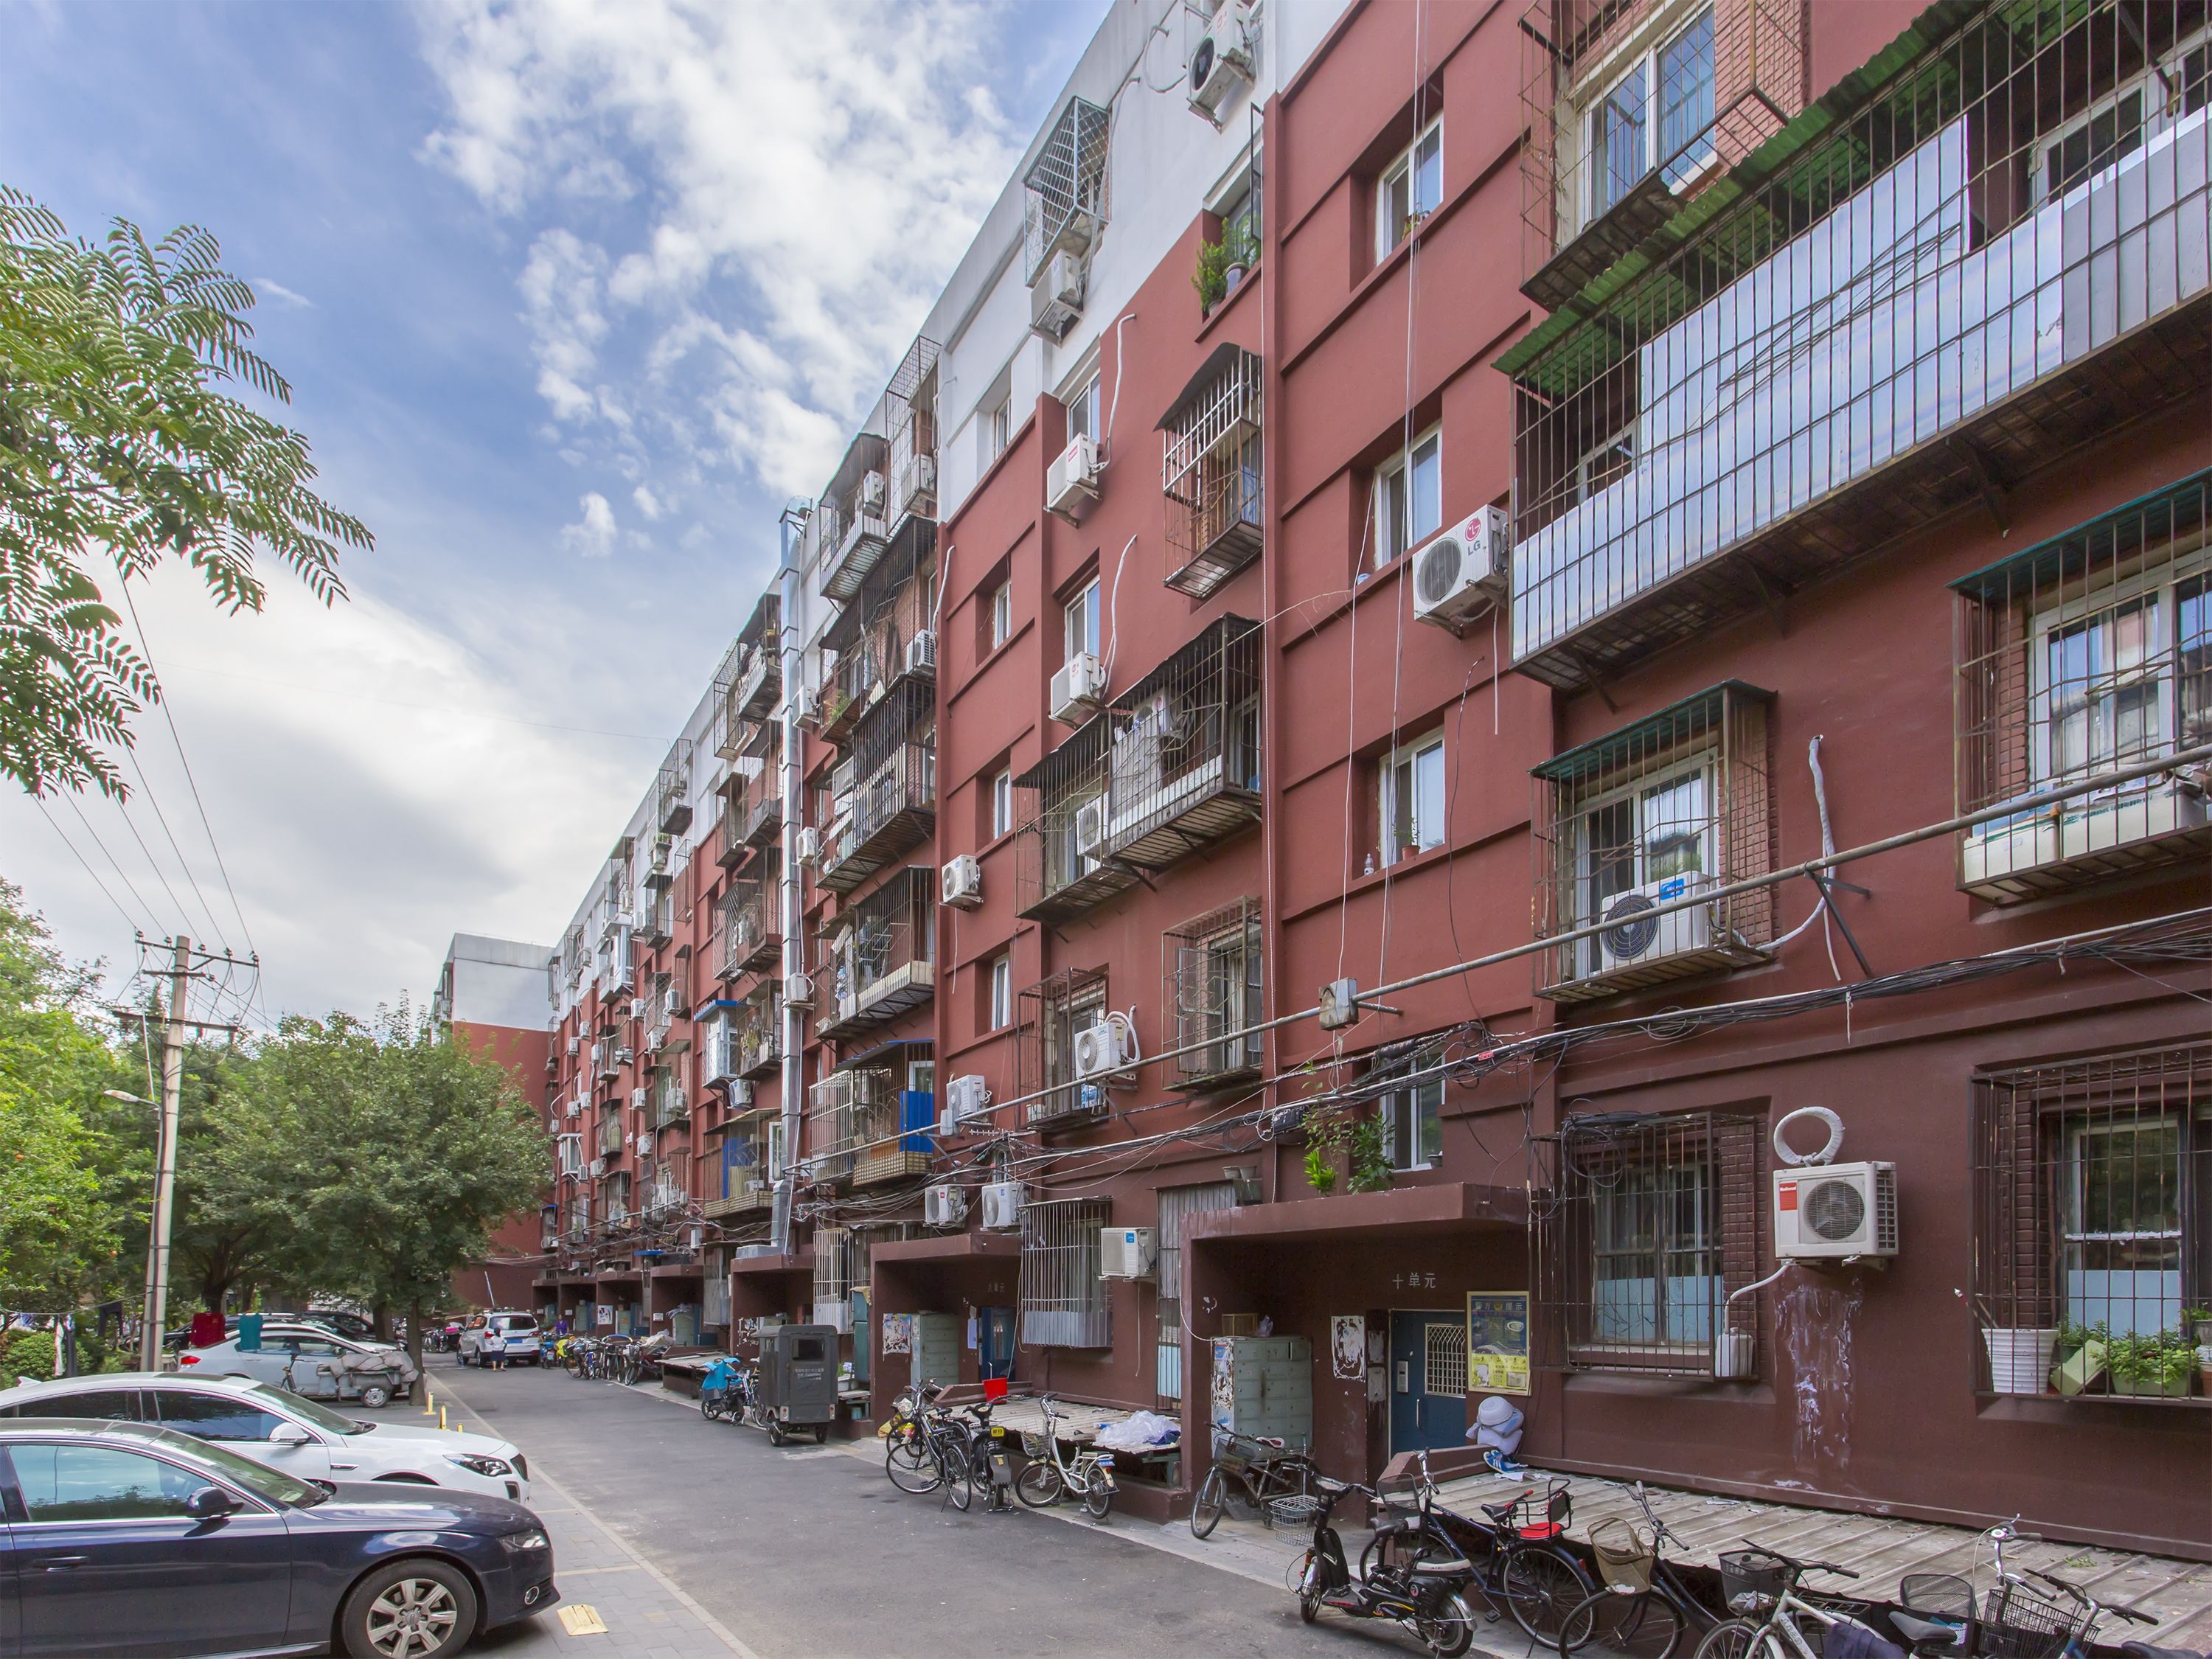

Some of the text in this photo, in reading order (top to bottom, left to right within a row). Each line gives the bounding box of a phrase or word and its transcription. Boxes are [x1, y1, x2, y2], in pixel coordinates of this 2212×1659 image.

[1467, 540, 1481, 556] LG
[1392, 1272, 1436, 1290] 十单元
